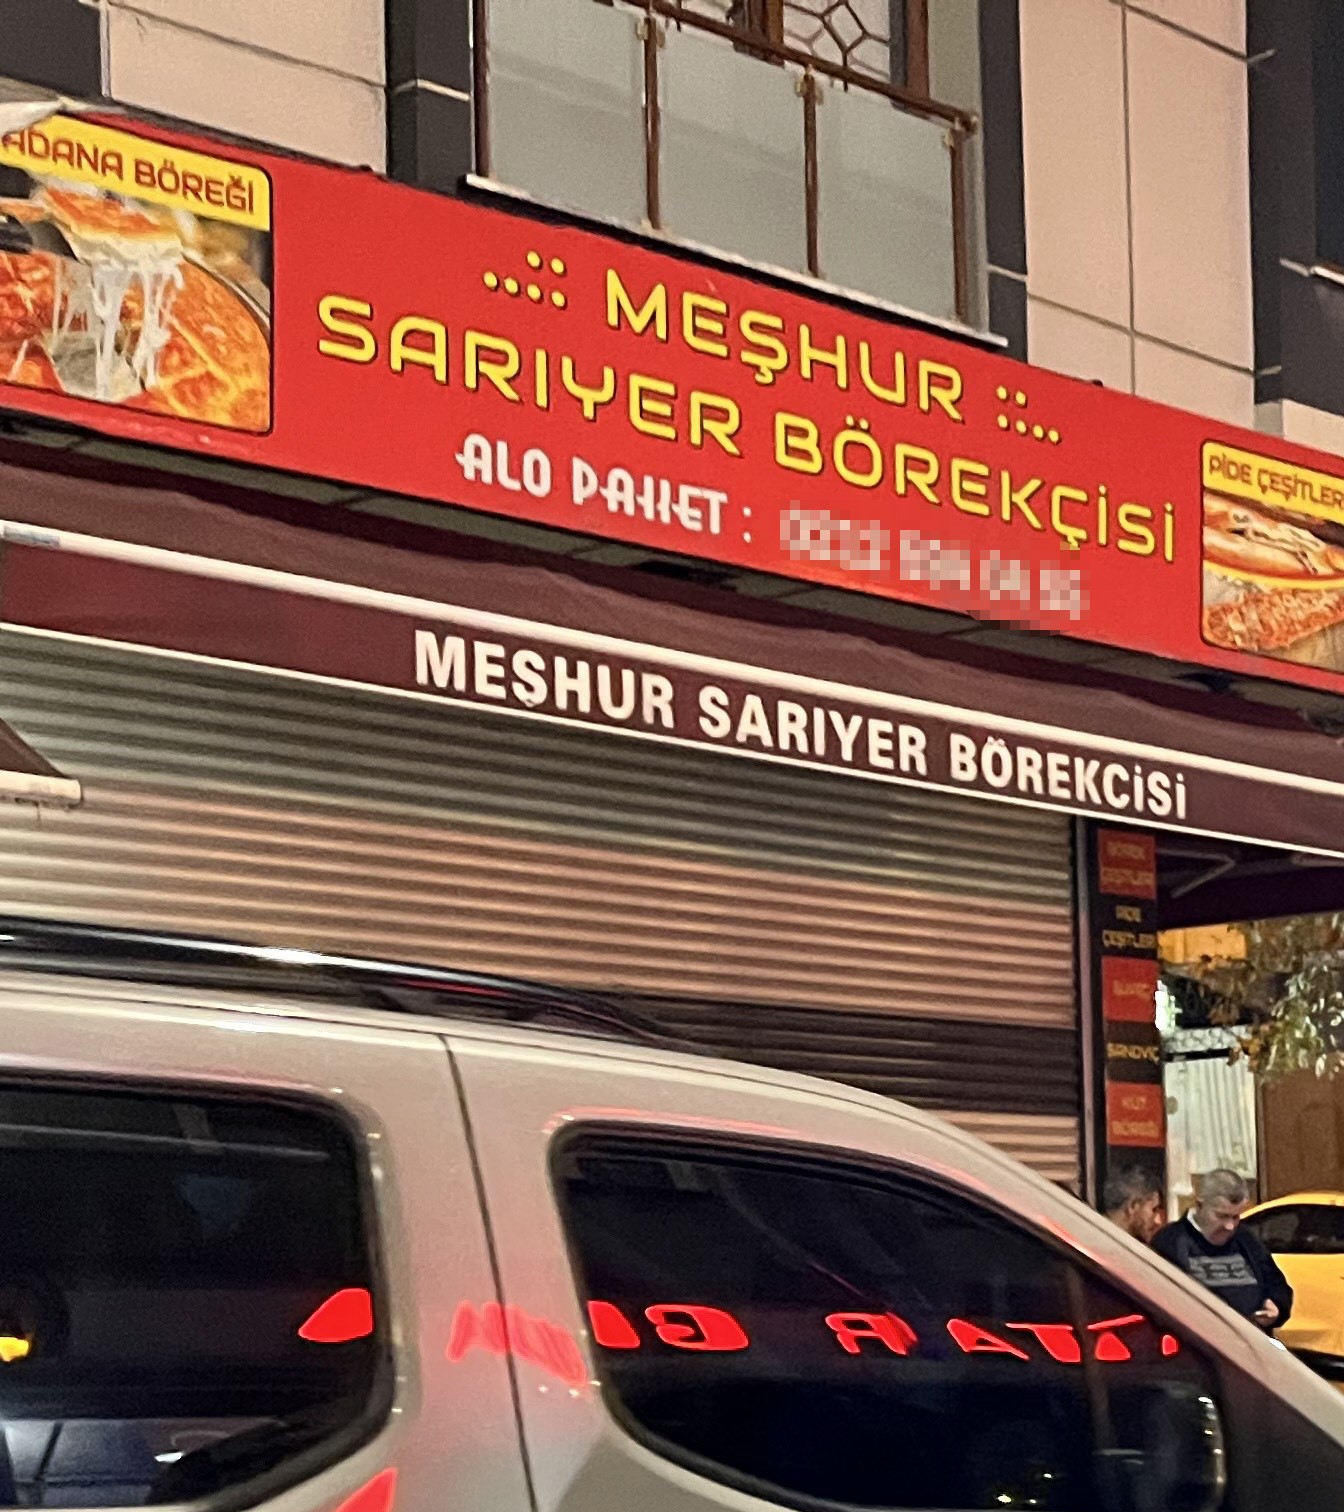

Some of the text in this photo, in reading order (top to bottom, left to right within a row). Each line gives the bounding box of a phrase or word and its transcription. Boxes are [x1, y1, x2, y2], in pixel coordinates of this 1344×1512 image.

[2, 127, 124, 182] ADANA
[605, 268, 964, 423] MEŞHUR
[317, 293, 1177, 562] SARIYER BÖREKÇİSİ
[455, 433, 551, 497] ALO
[1208, 453, 1253, 486] PİDE
[697, 685, 928, 776] SARIYER
